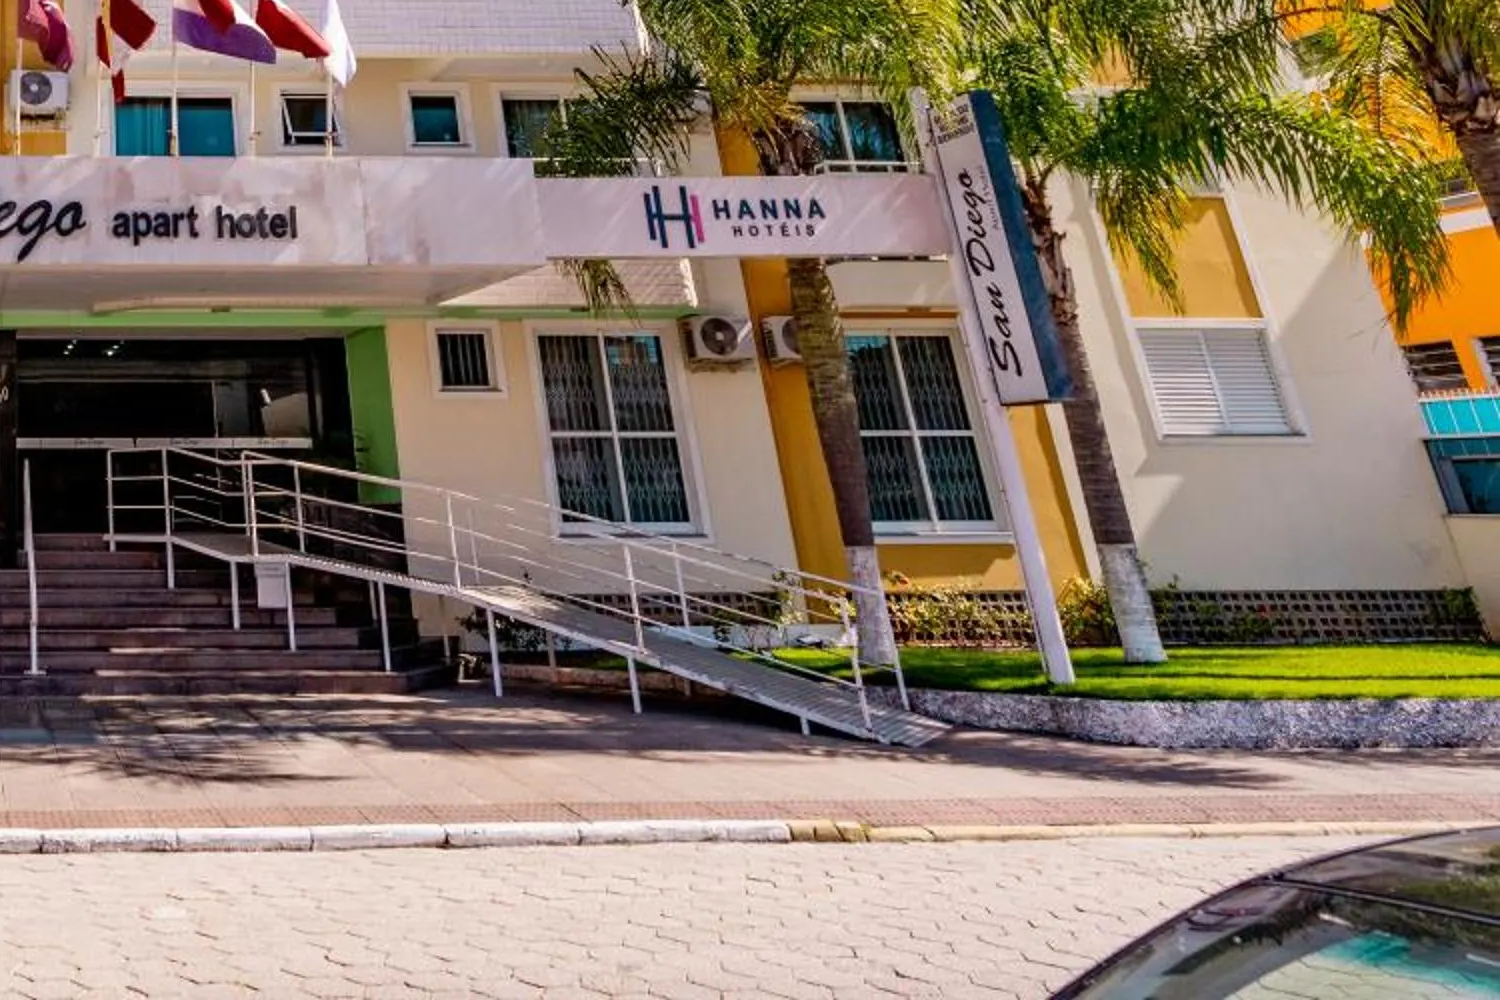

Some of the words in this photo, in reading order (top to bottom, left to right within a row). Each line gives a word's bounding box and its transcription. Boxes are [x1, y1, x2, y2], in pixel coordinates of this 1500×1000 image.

[111, 205, 200, 247] apart
[215, 205, 298, 240] hotel
[712, 198, 827, 221] HANNA
[731, 221, 816, 238] HOTÉIS
[957, 166, 998, 279] Diego
[988, 283, 1023, 378] San
